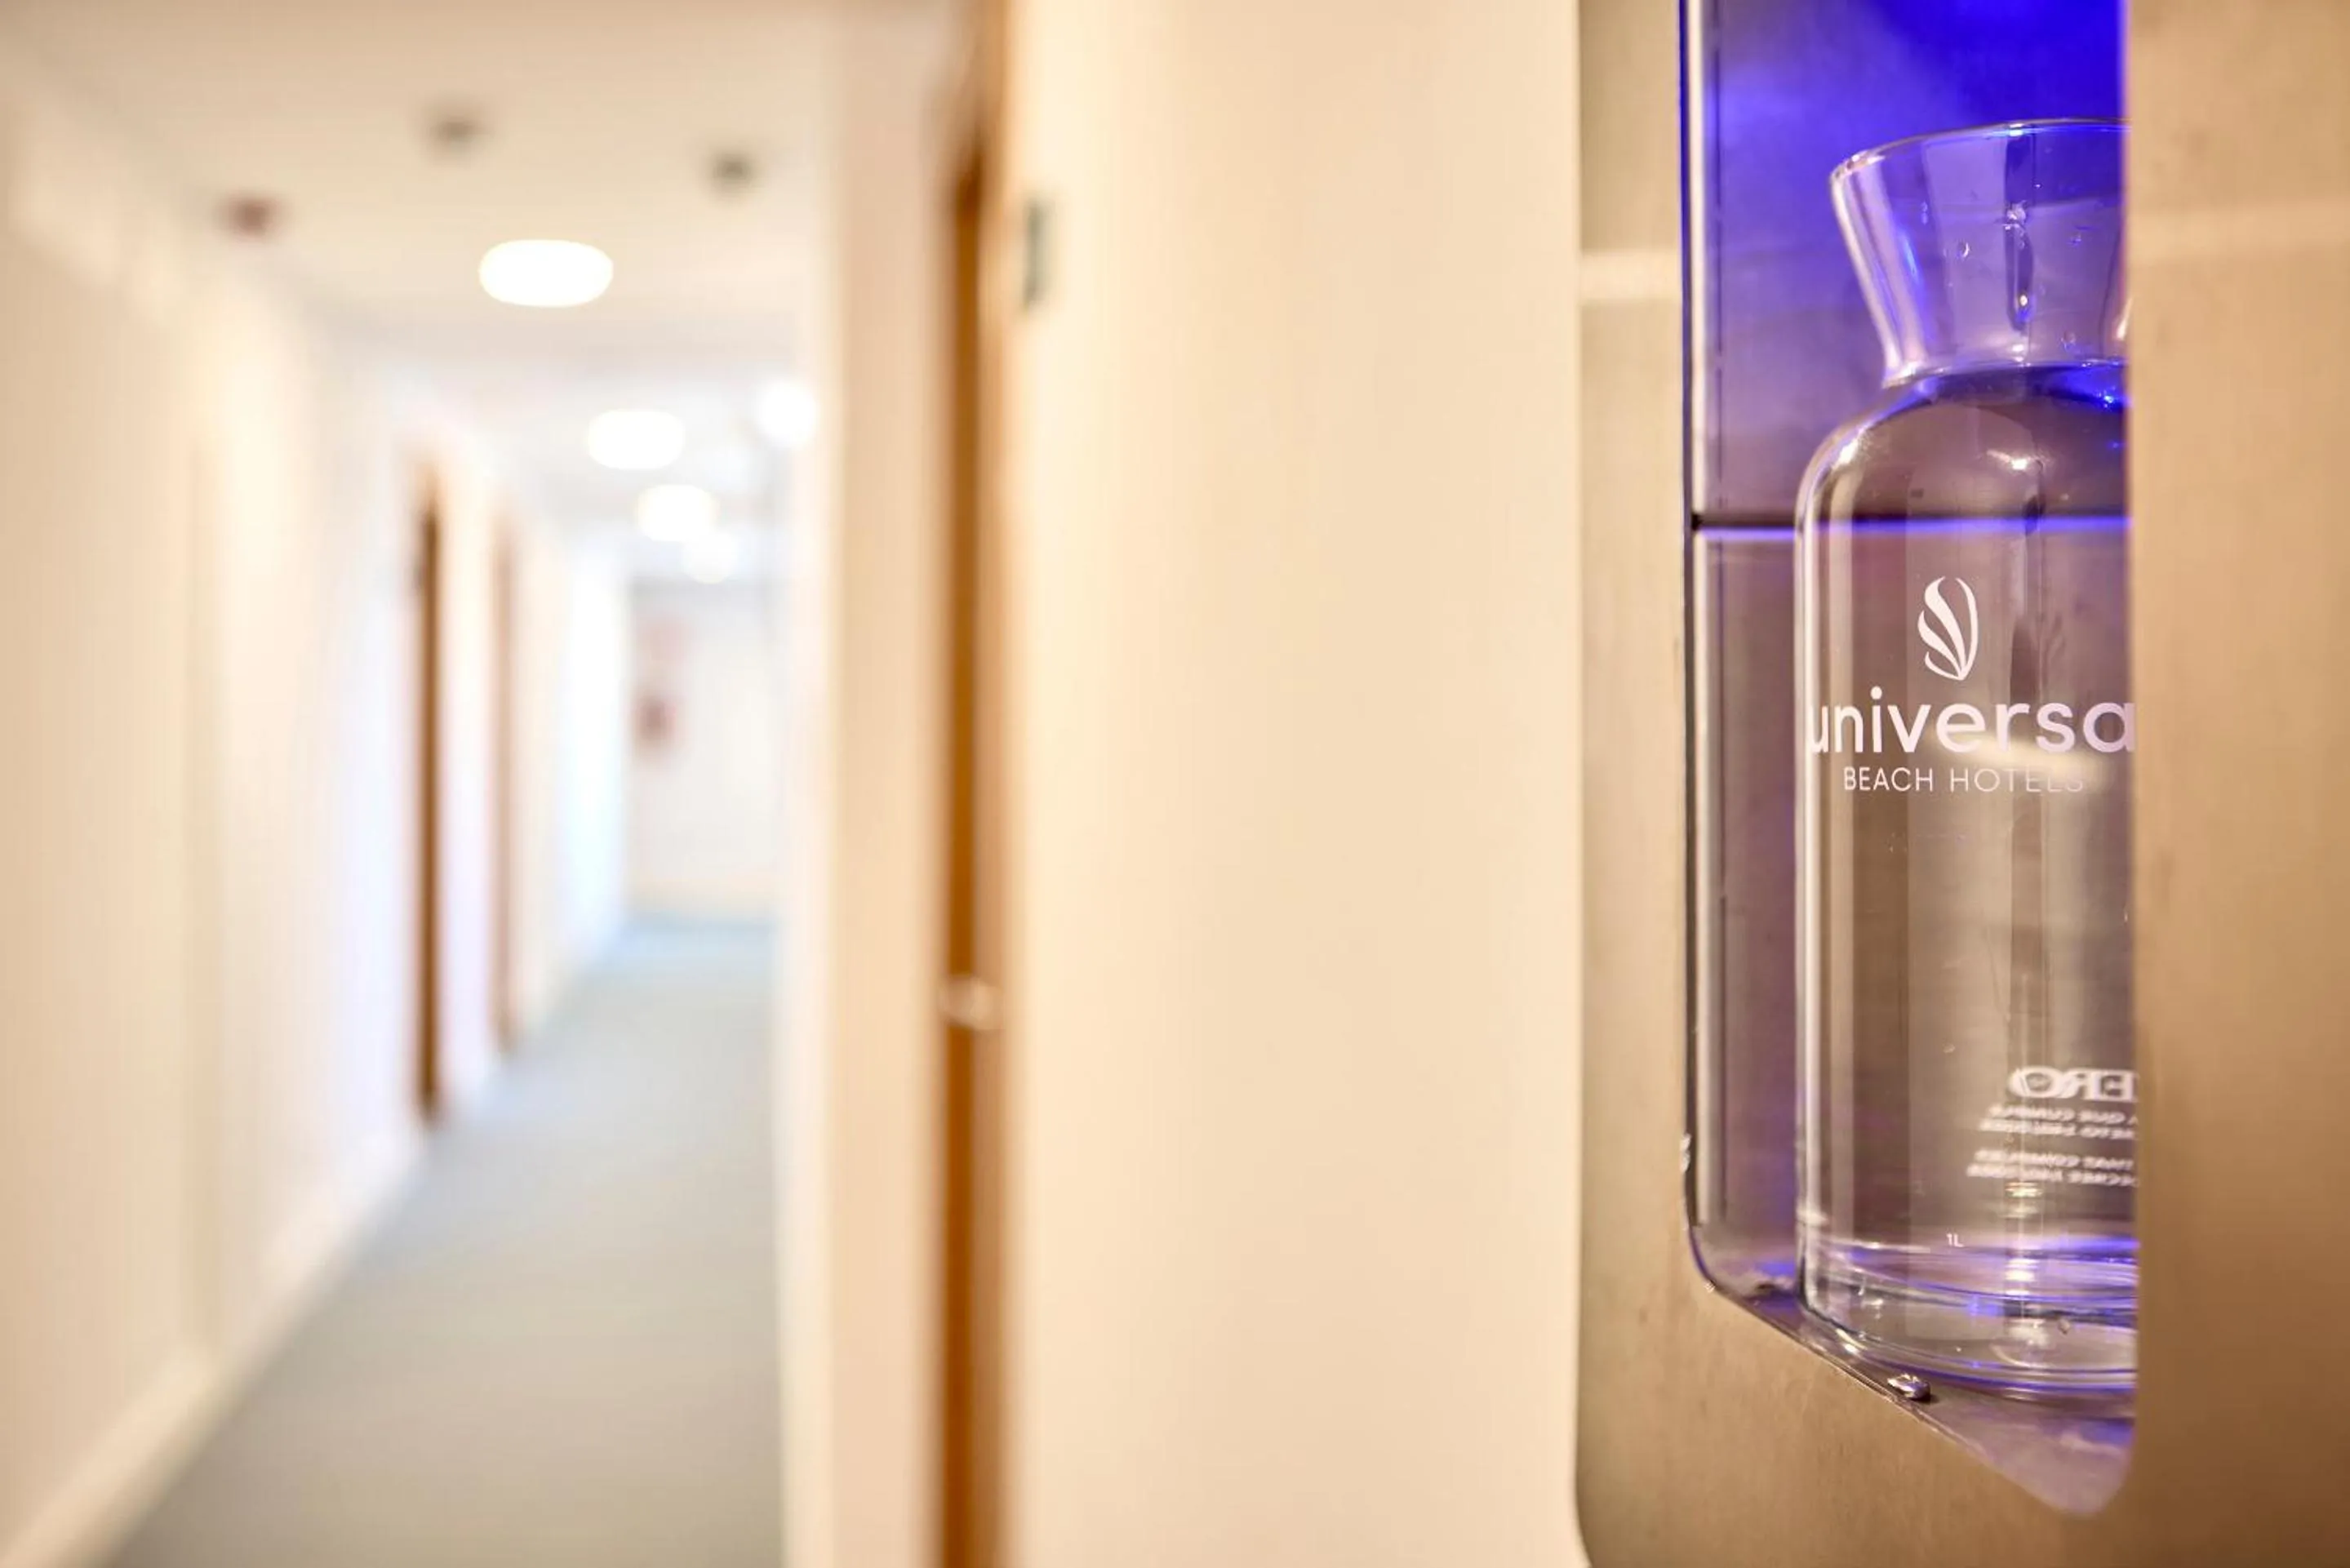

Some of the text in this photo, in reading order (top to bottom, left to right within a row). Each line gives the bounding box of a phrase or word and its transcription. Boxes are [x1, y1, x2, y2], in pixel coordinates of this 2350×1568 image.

[1843, 766, 2083, 793] BEACH HOTELS
[1946, 1233, 1965, 1247] 1L
